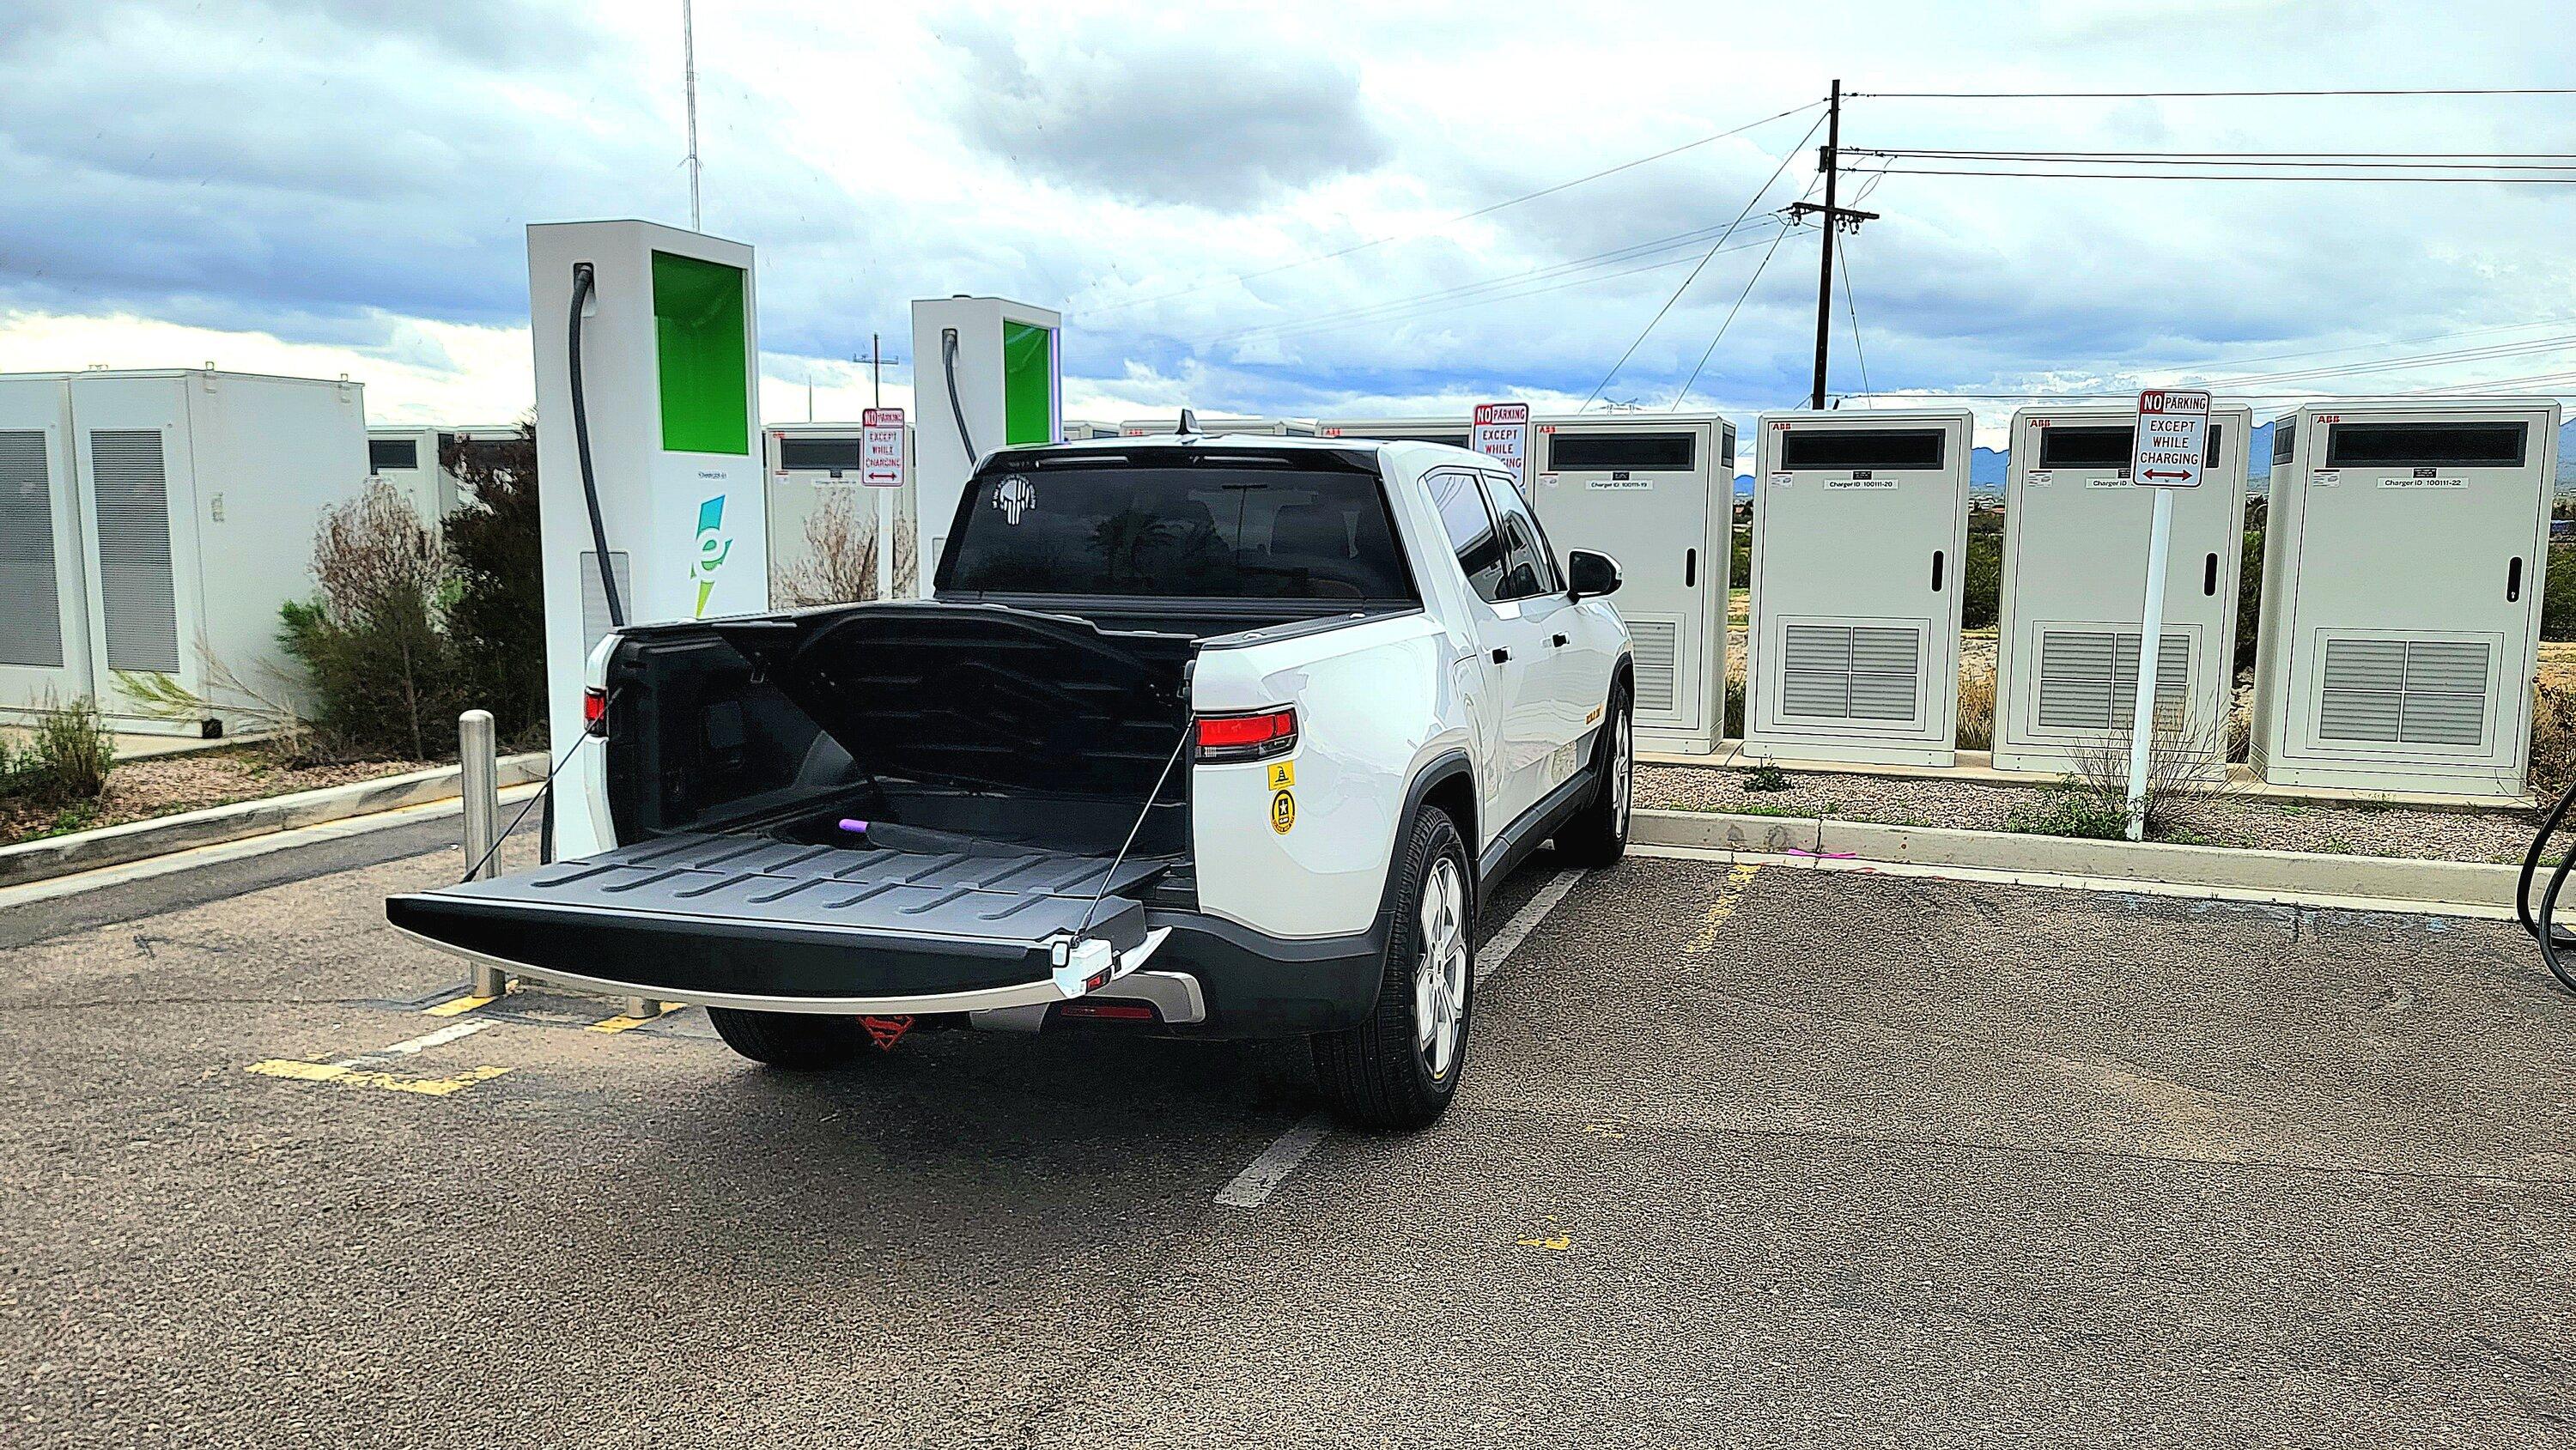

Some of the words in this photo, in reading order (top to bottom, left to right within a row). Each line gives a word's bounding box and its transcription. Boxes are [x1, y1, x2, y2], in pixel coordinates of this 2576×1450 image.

[2143, 394, 2163, 410] NO
[2165, 397, 2206, 410] PARKING
[865, 410, 877, 425] NO
[1476, 407, 1492, 423] NO
[1493, 409, 1525, 420] PARKING
[2317, 416, 2341, 424] ABB
[2030, 419, 2051, 428] ABB
[2150, 420, 2196, 432] EXCEPT
[869, 433, 897, 441] EXCEPT
[1482, 429, 1517, 440] EXCEPT
[2153, 436, 2190, 448] WHILE
[1485, 444, 1514, 454] WHILE
[2140, 452, 2199, 465] CHARGING
